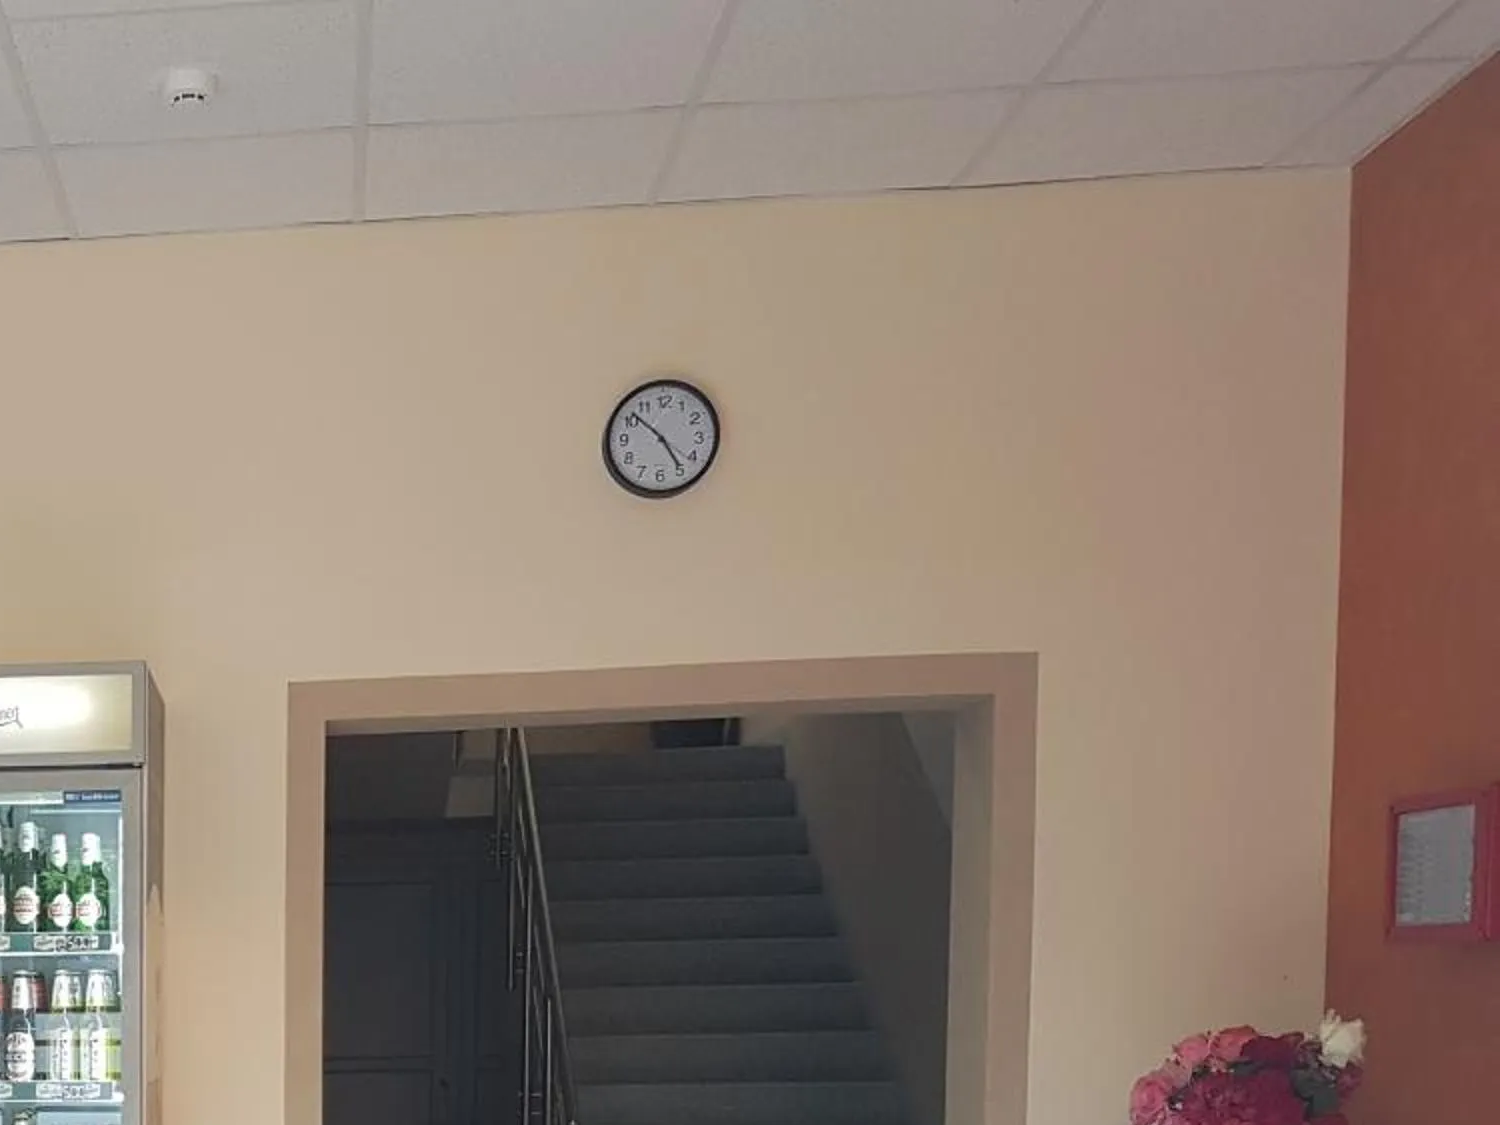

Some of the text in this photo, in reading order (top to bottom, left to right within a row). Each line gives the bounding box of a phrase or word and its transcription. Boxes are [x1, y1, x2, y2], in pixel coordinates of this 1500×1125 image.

[639, 401, 651, 413] 11
[657, 395, 672, 408] 12
[678, 401, 685, 411] 1
[625, 415, 639, 428] 10
[689, 411, 701, 425] 2
[619, 433, 629, 446] 9
[693, 430, 705, 444] 3
[623, 451, 634, 464] 8
[687, 449, 698, 461] 4
[636, 465, 647, 478] 7
[655, 469, 665, 482] 6
[675, 464, 685, 477] 5
